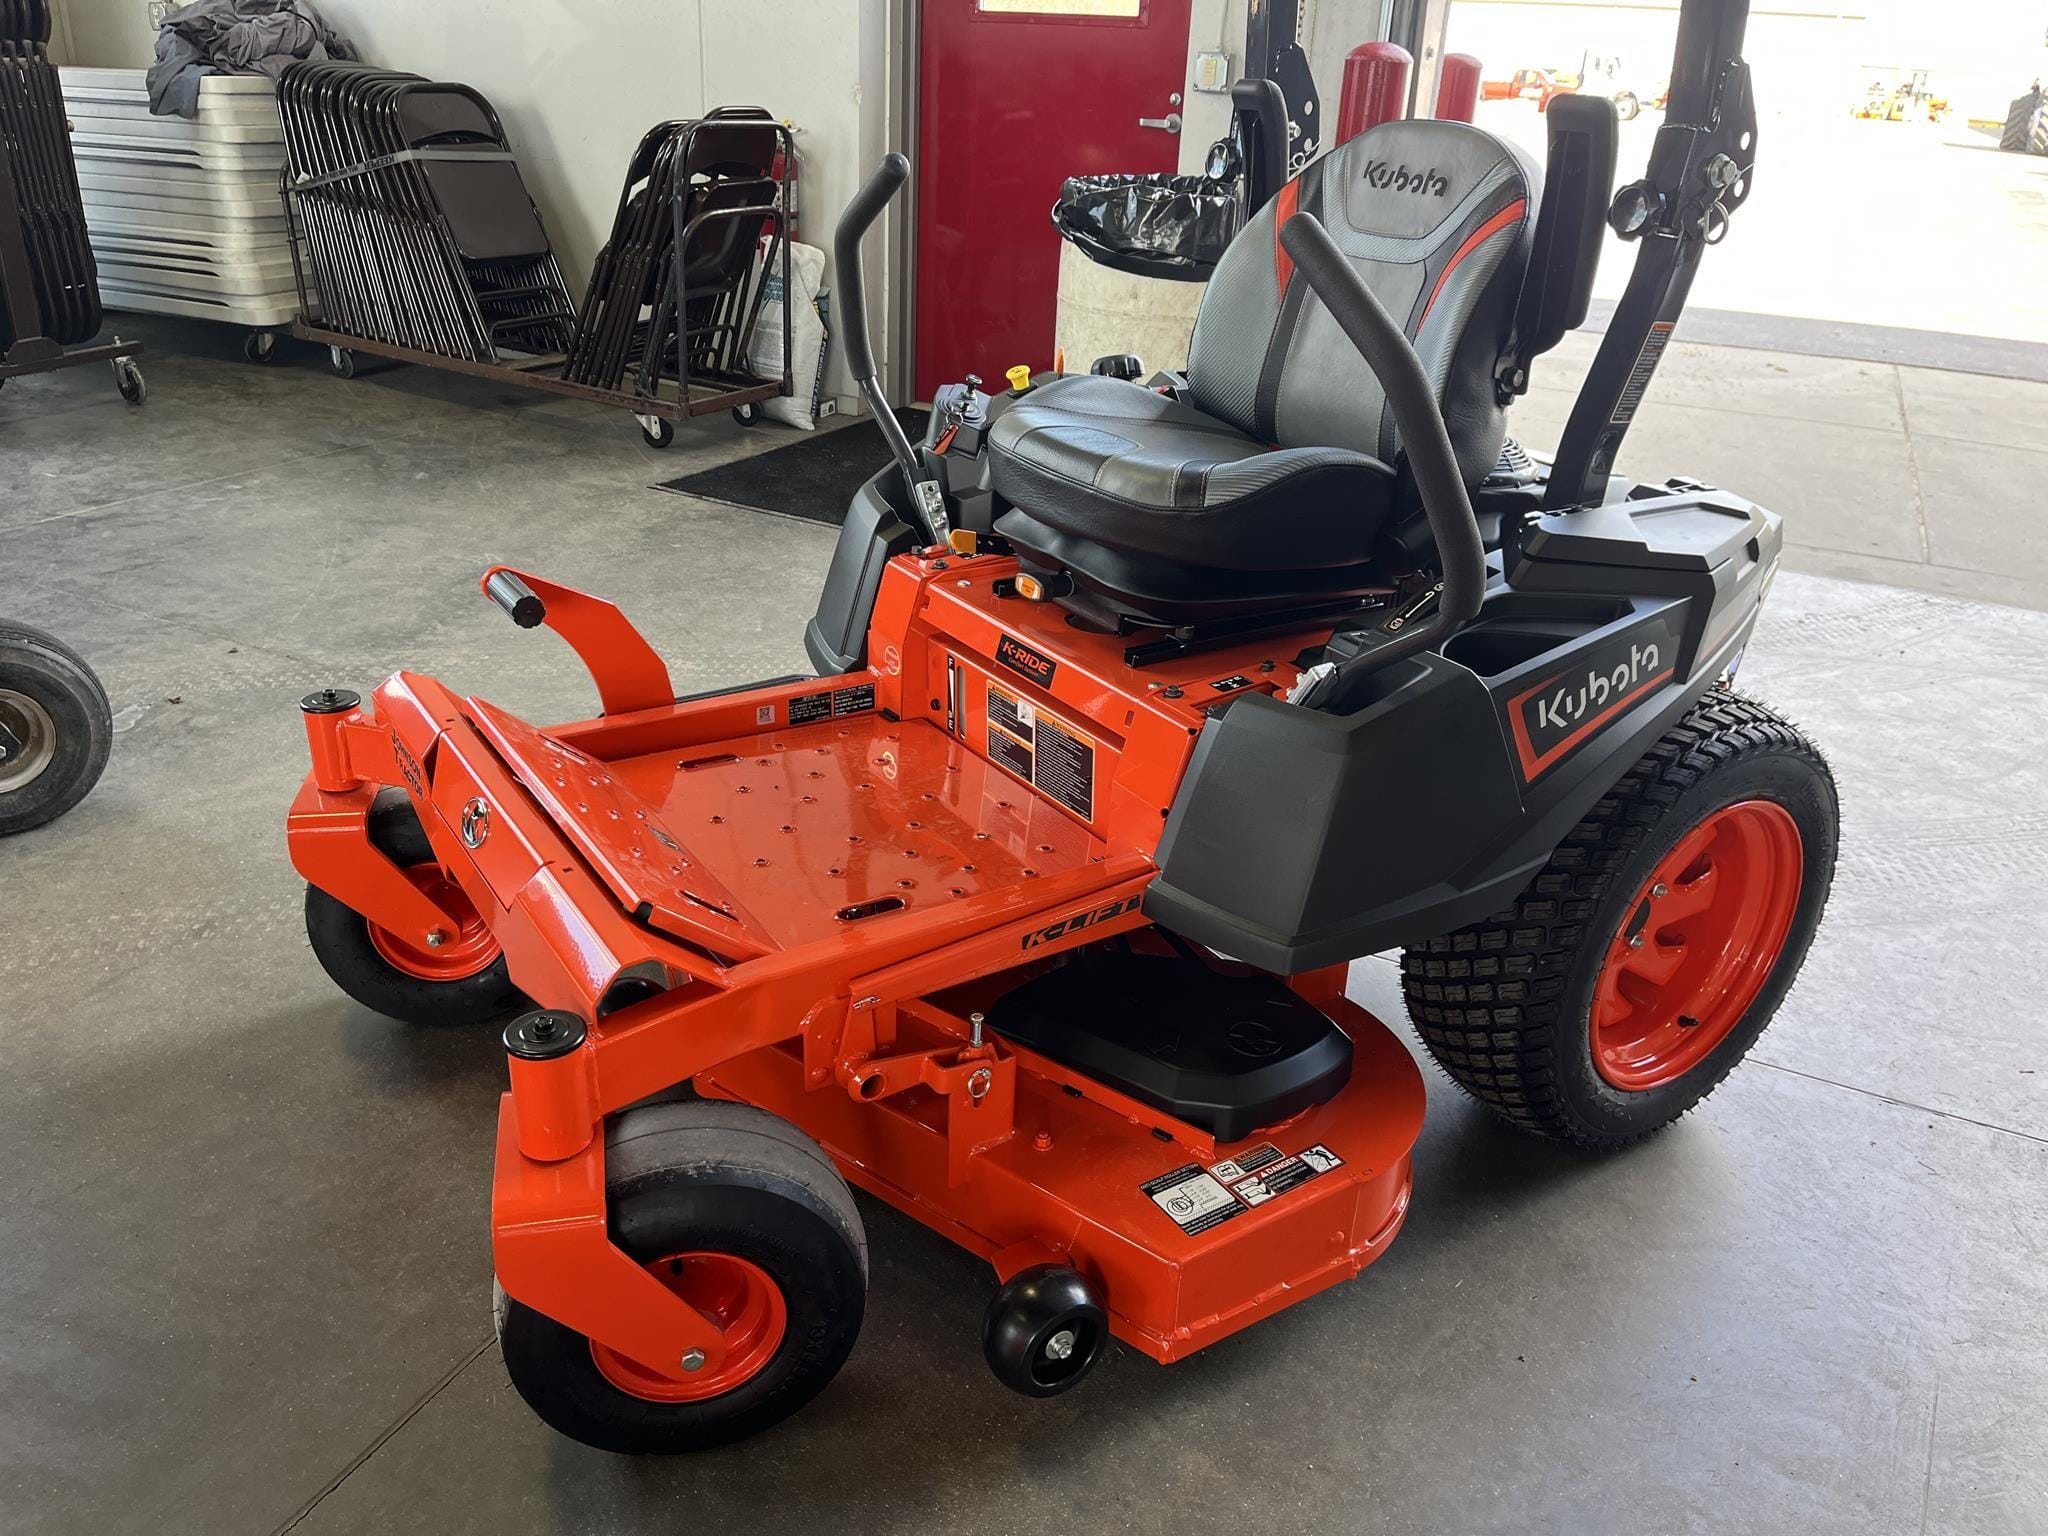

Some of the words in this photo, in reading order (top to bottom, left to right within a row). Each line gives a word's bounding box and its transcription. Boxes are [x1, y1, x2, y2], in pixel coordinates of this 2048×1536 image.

[364, 154, 395, 171] KEEPER
[1363, 160, 1448, 197] Kubota
[1002, 641, 1051, 675] K-RIDE
[1538, 643, 1660, 729] Kubota
[1025, 895, 1139, 950] K-LIFT
[1266, 1156, 1299, 1176] DANGER
